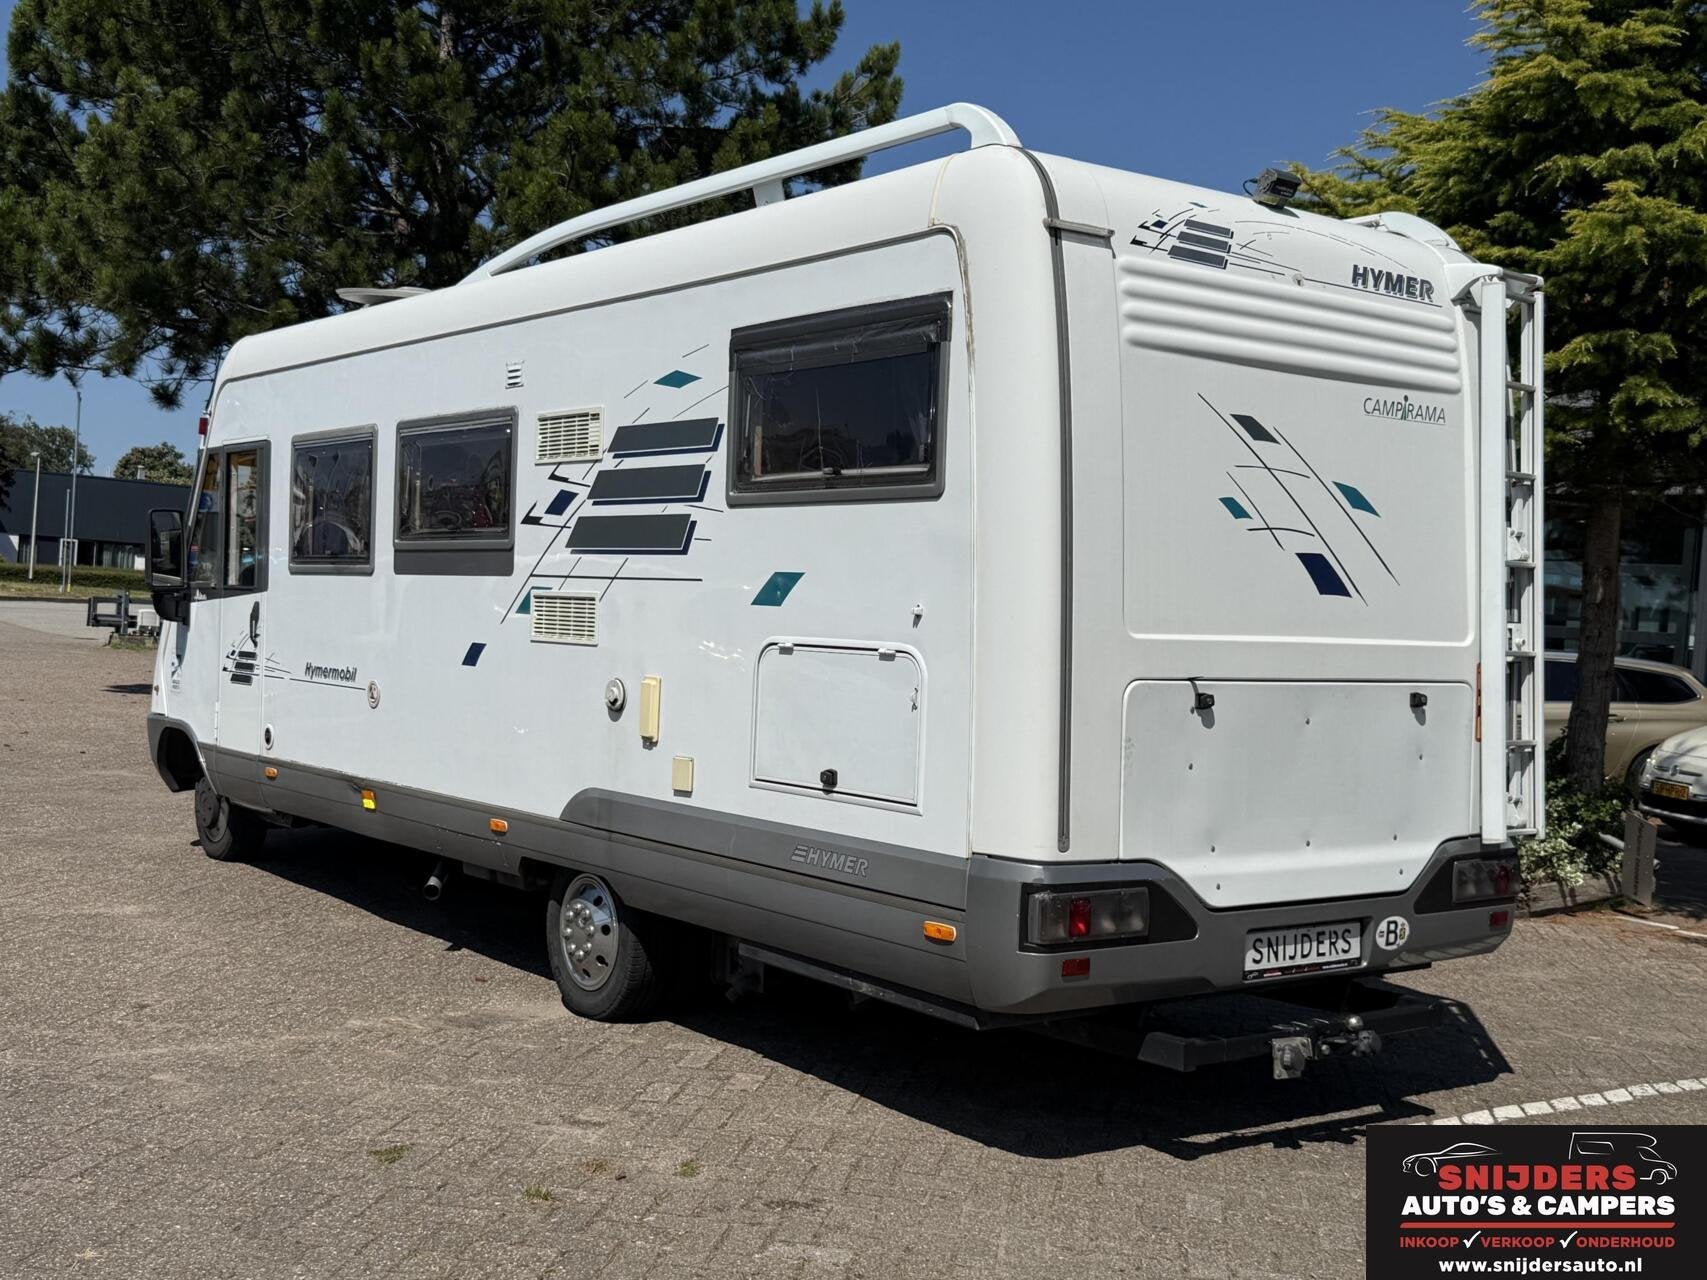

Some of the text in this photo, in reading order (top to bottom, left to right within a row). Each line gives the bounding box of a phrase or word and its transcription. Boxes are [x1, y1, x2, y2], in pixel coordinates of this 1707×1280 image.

[1351, 264, 1435, 303] HYMER
[304, 661, 358, 683] Hymermobil
[805, 846, 869, 877] HYMER
[1252, 929, 1352, 965] SNIJDERS
[1385, 920, 1399, 947] B
